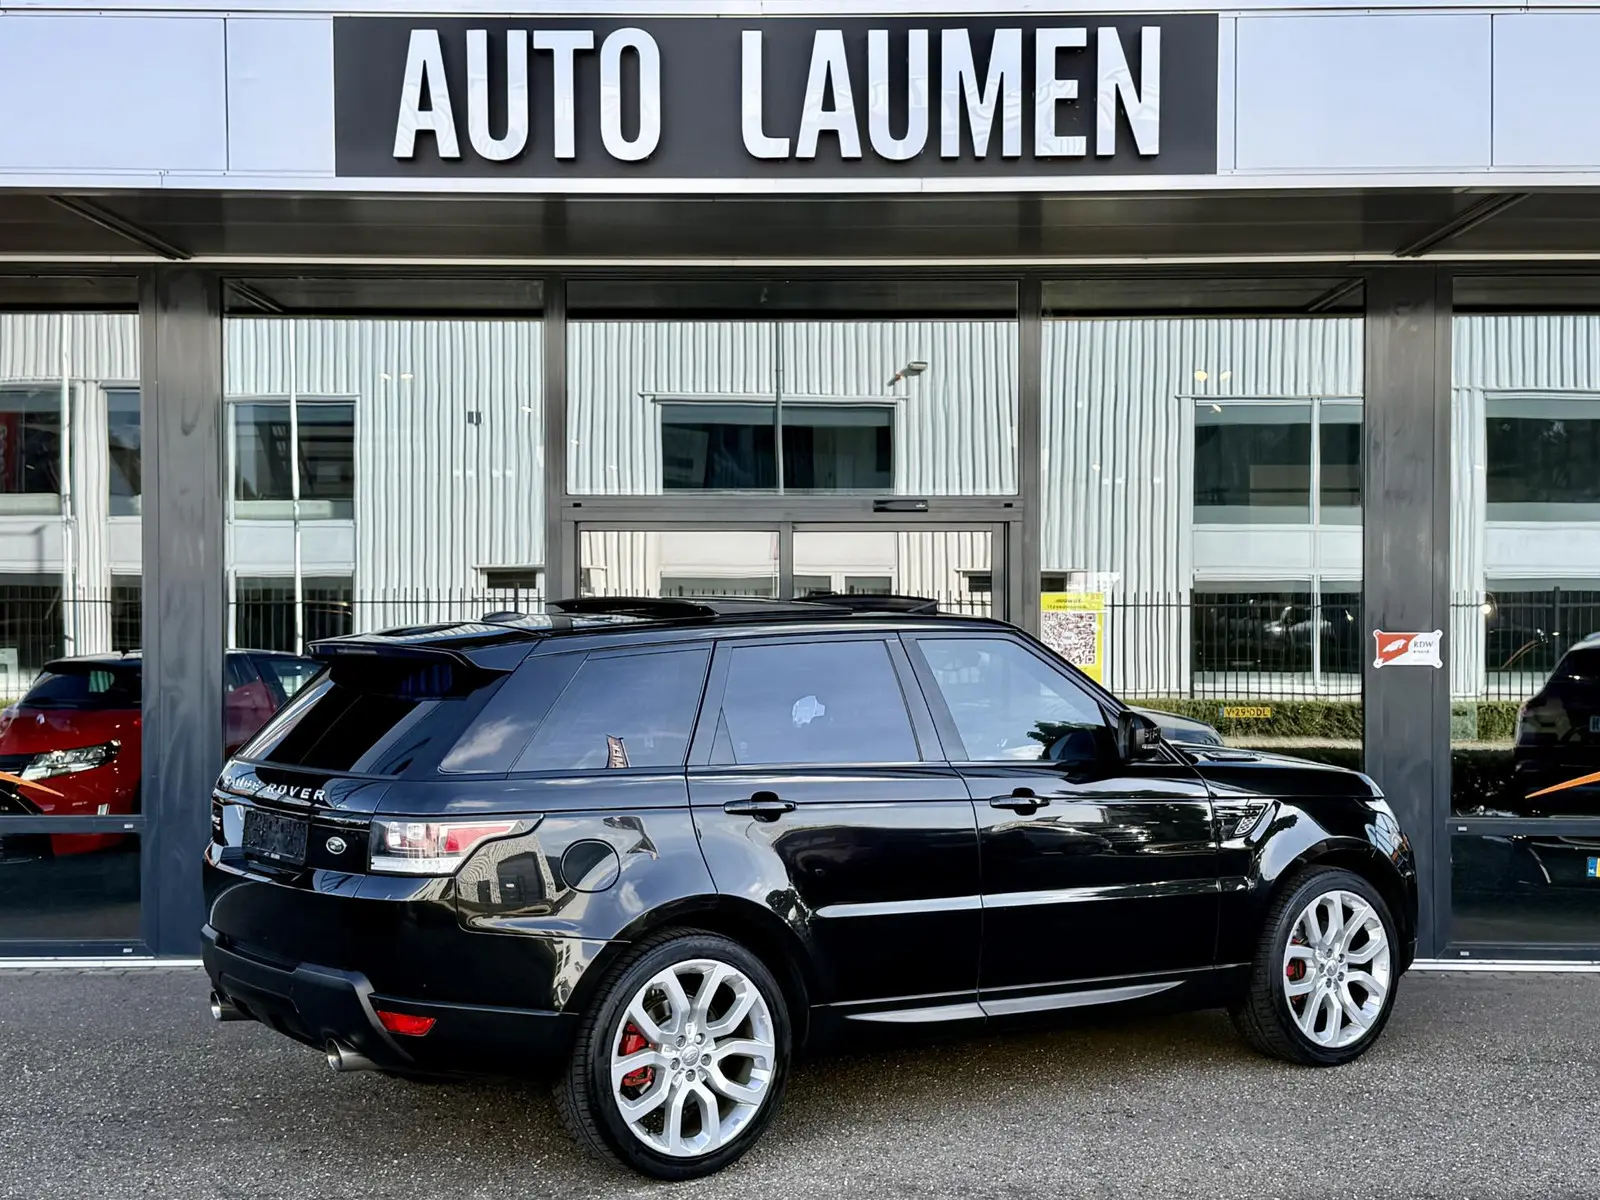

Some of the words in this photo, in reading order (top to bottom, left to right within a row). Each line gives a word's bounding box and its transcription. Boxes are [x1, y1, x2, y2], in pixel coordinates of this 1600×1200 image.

[392, 27, 661, 162] AUTO
[740, 25, 1162, 161] LAUMEN
[1413, 640, 1434, 648] RDW
[266, 782, 326, 801] ROVER
